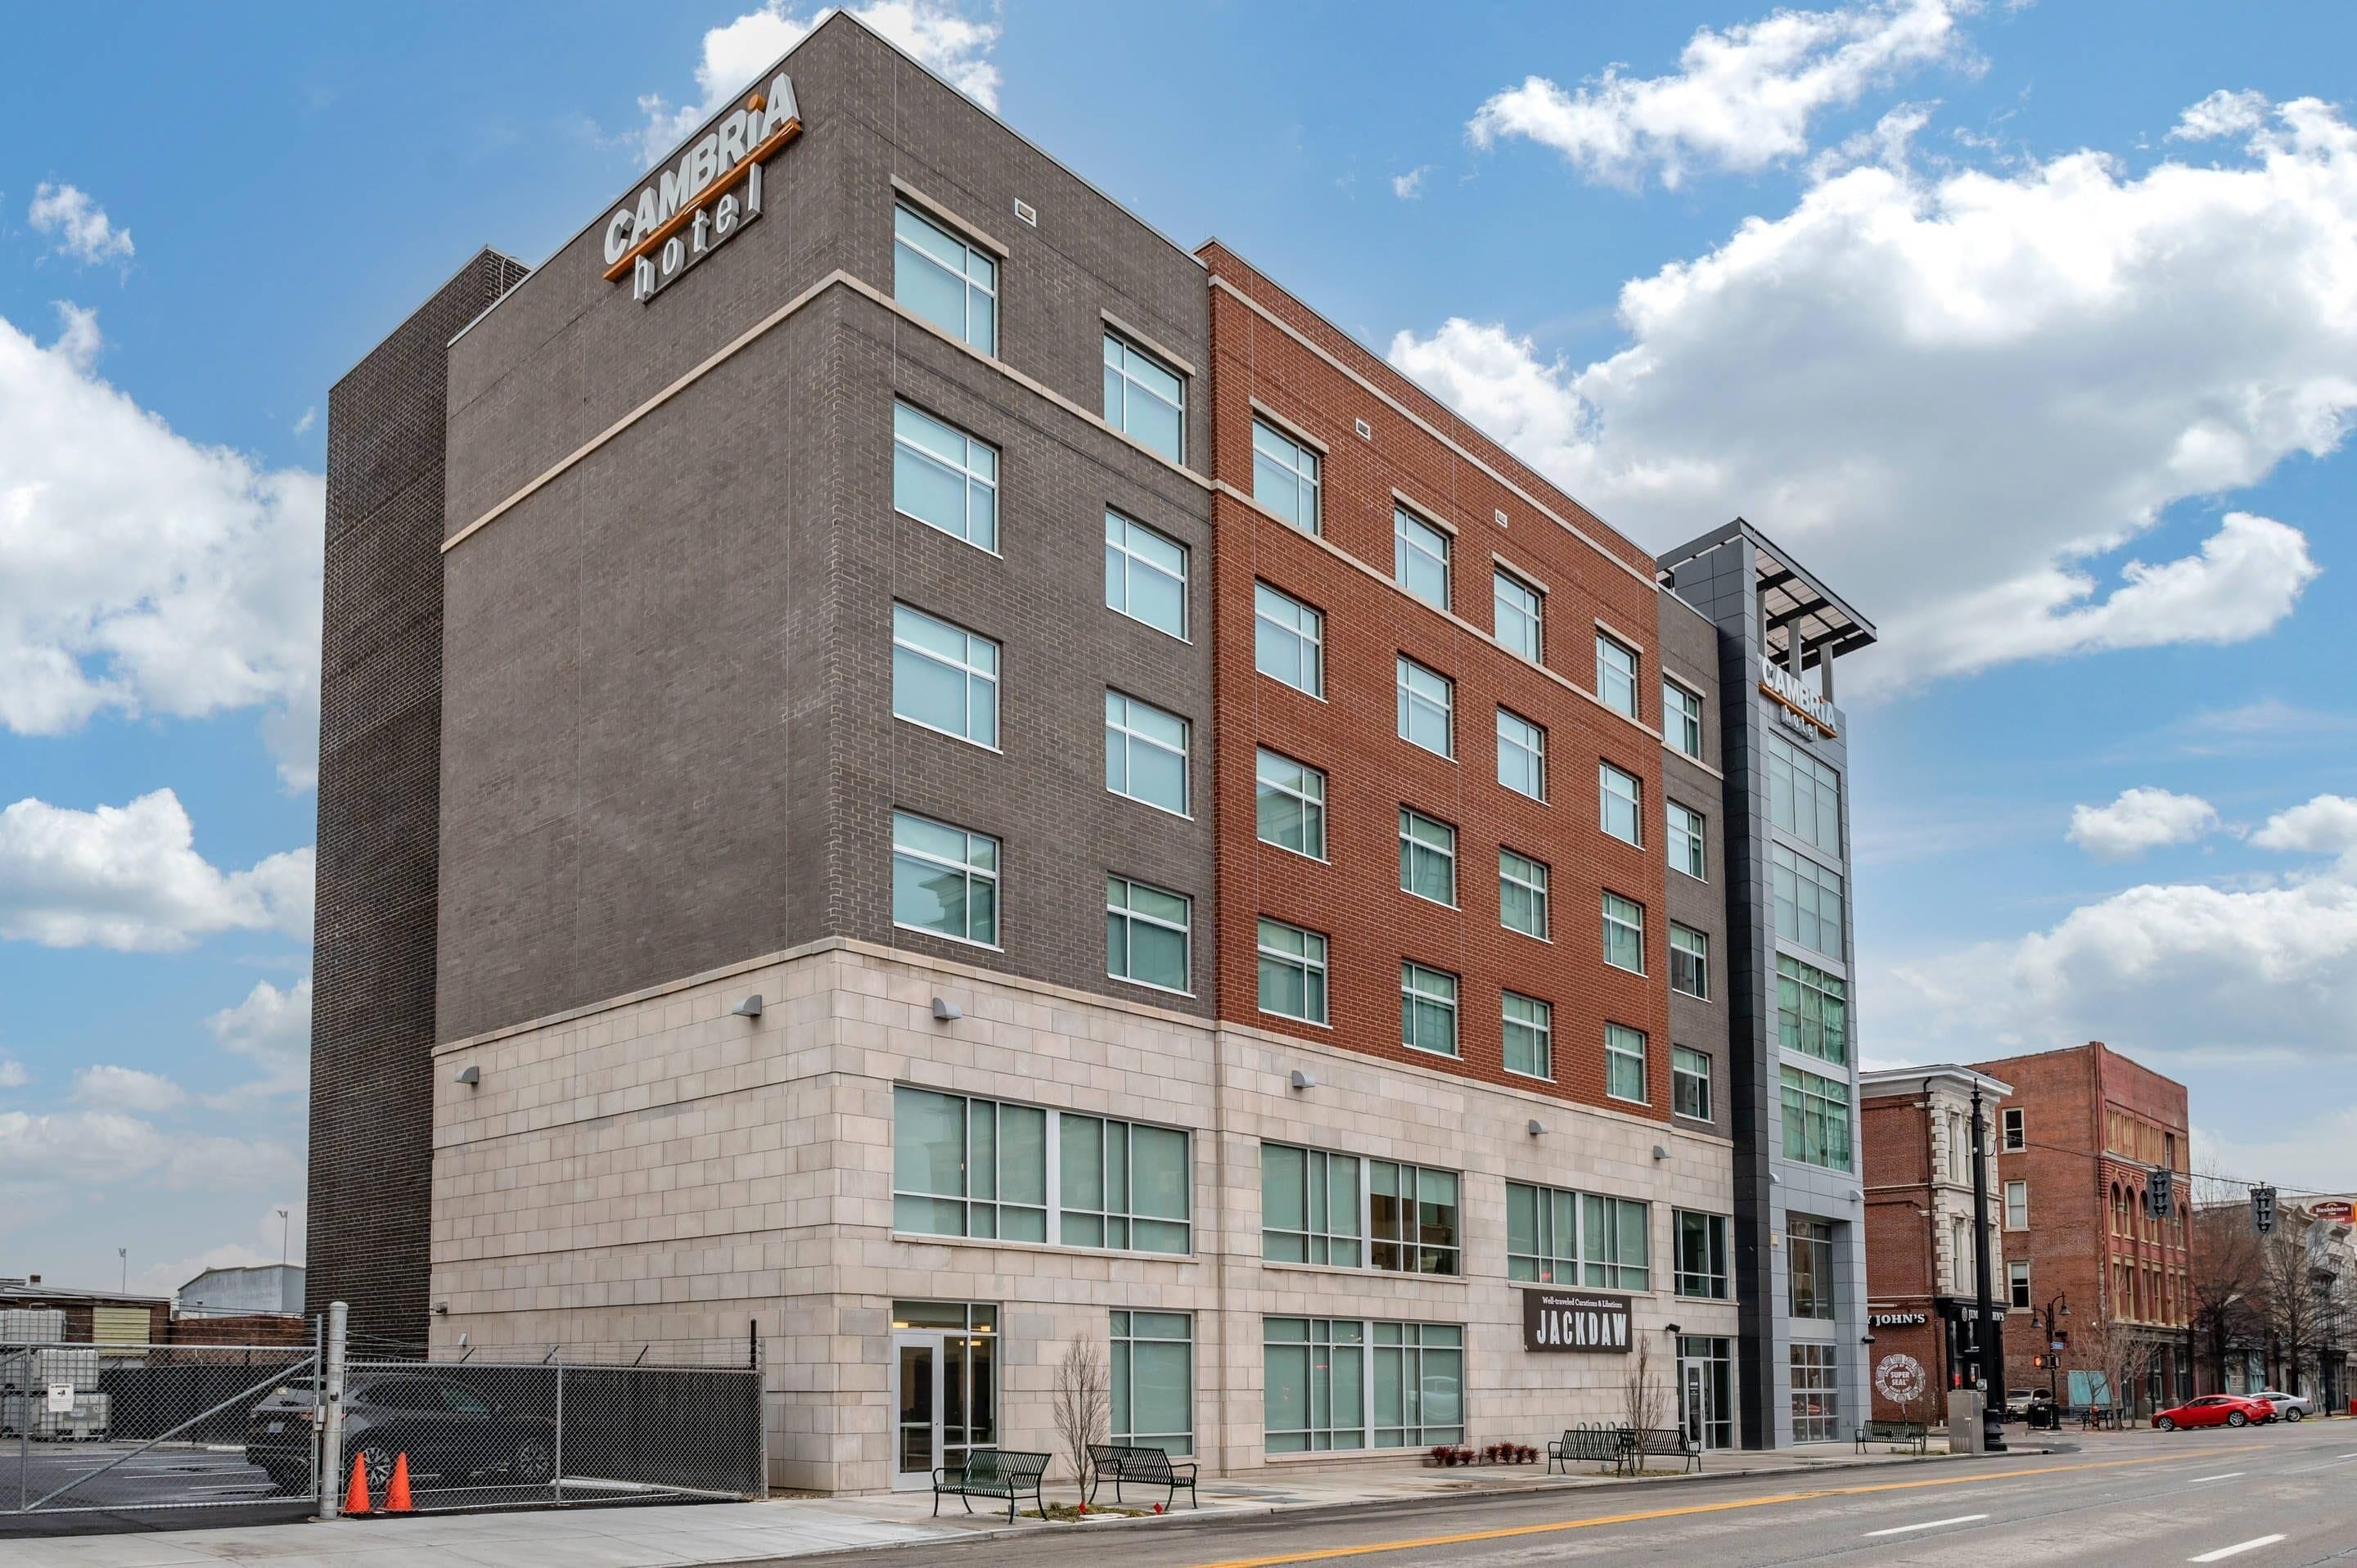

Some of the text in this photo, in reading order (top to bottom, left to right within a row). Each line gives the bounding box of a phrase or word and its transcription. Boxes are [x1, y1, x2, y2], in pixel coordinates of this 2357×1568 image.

[633, 162, 763, 302] hotel
[1782, 705, 1818, 741] hotel
[1542, 1295, 1575, 1306] Well-traveled
[1876, 1313, 1925, 1327] JOHN'S
[1968, 1309, 1978, 1321] JIM
[1536, 1309, 1627, 1346] JACKDAW
[1891, 1371, 1910, 1379] SUPER
